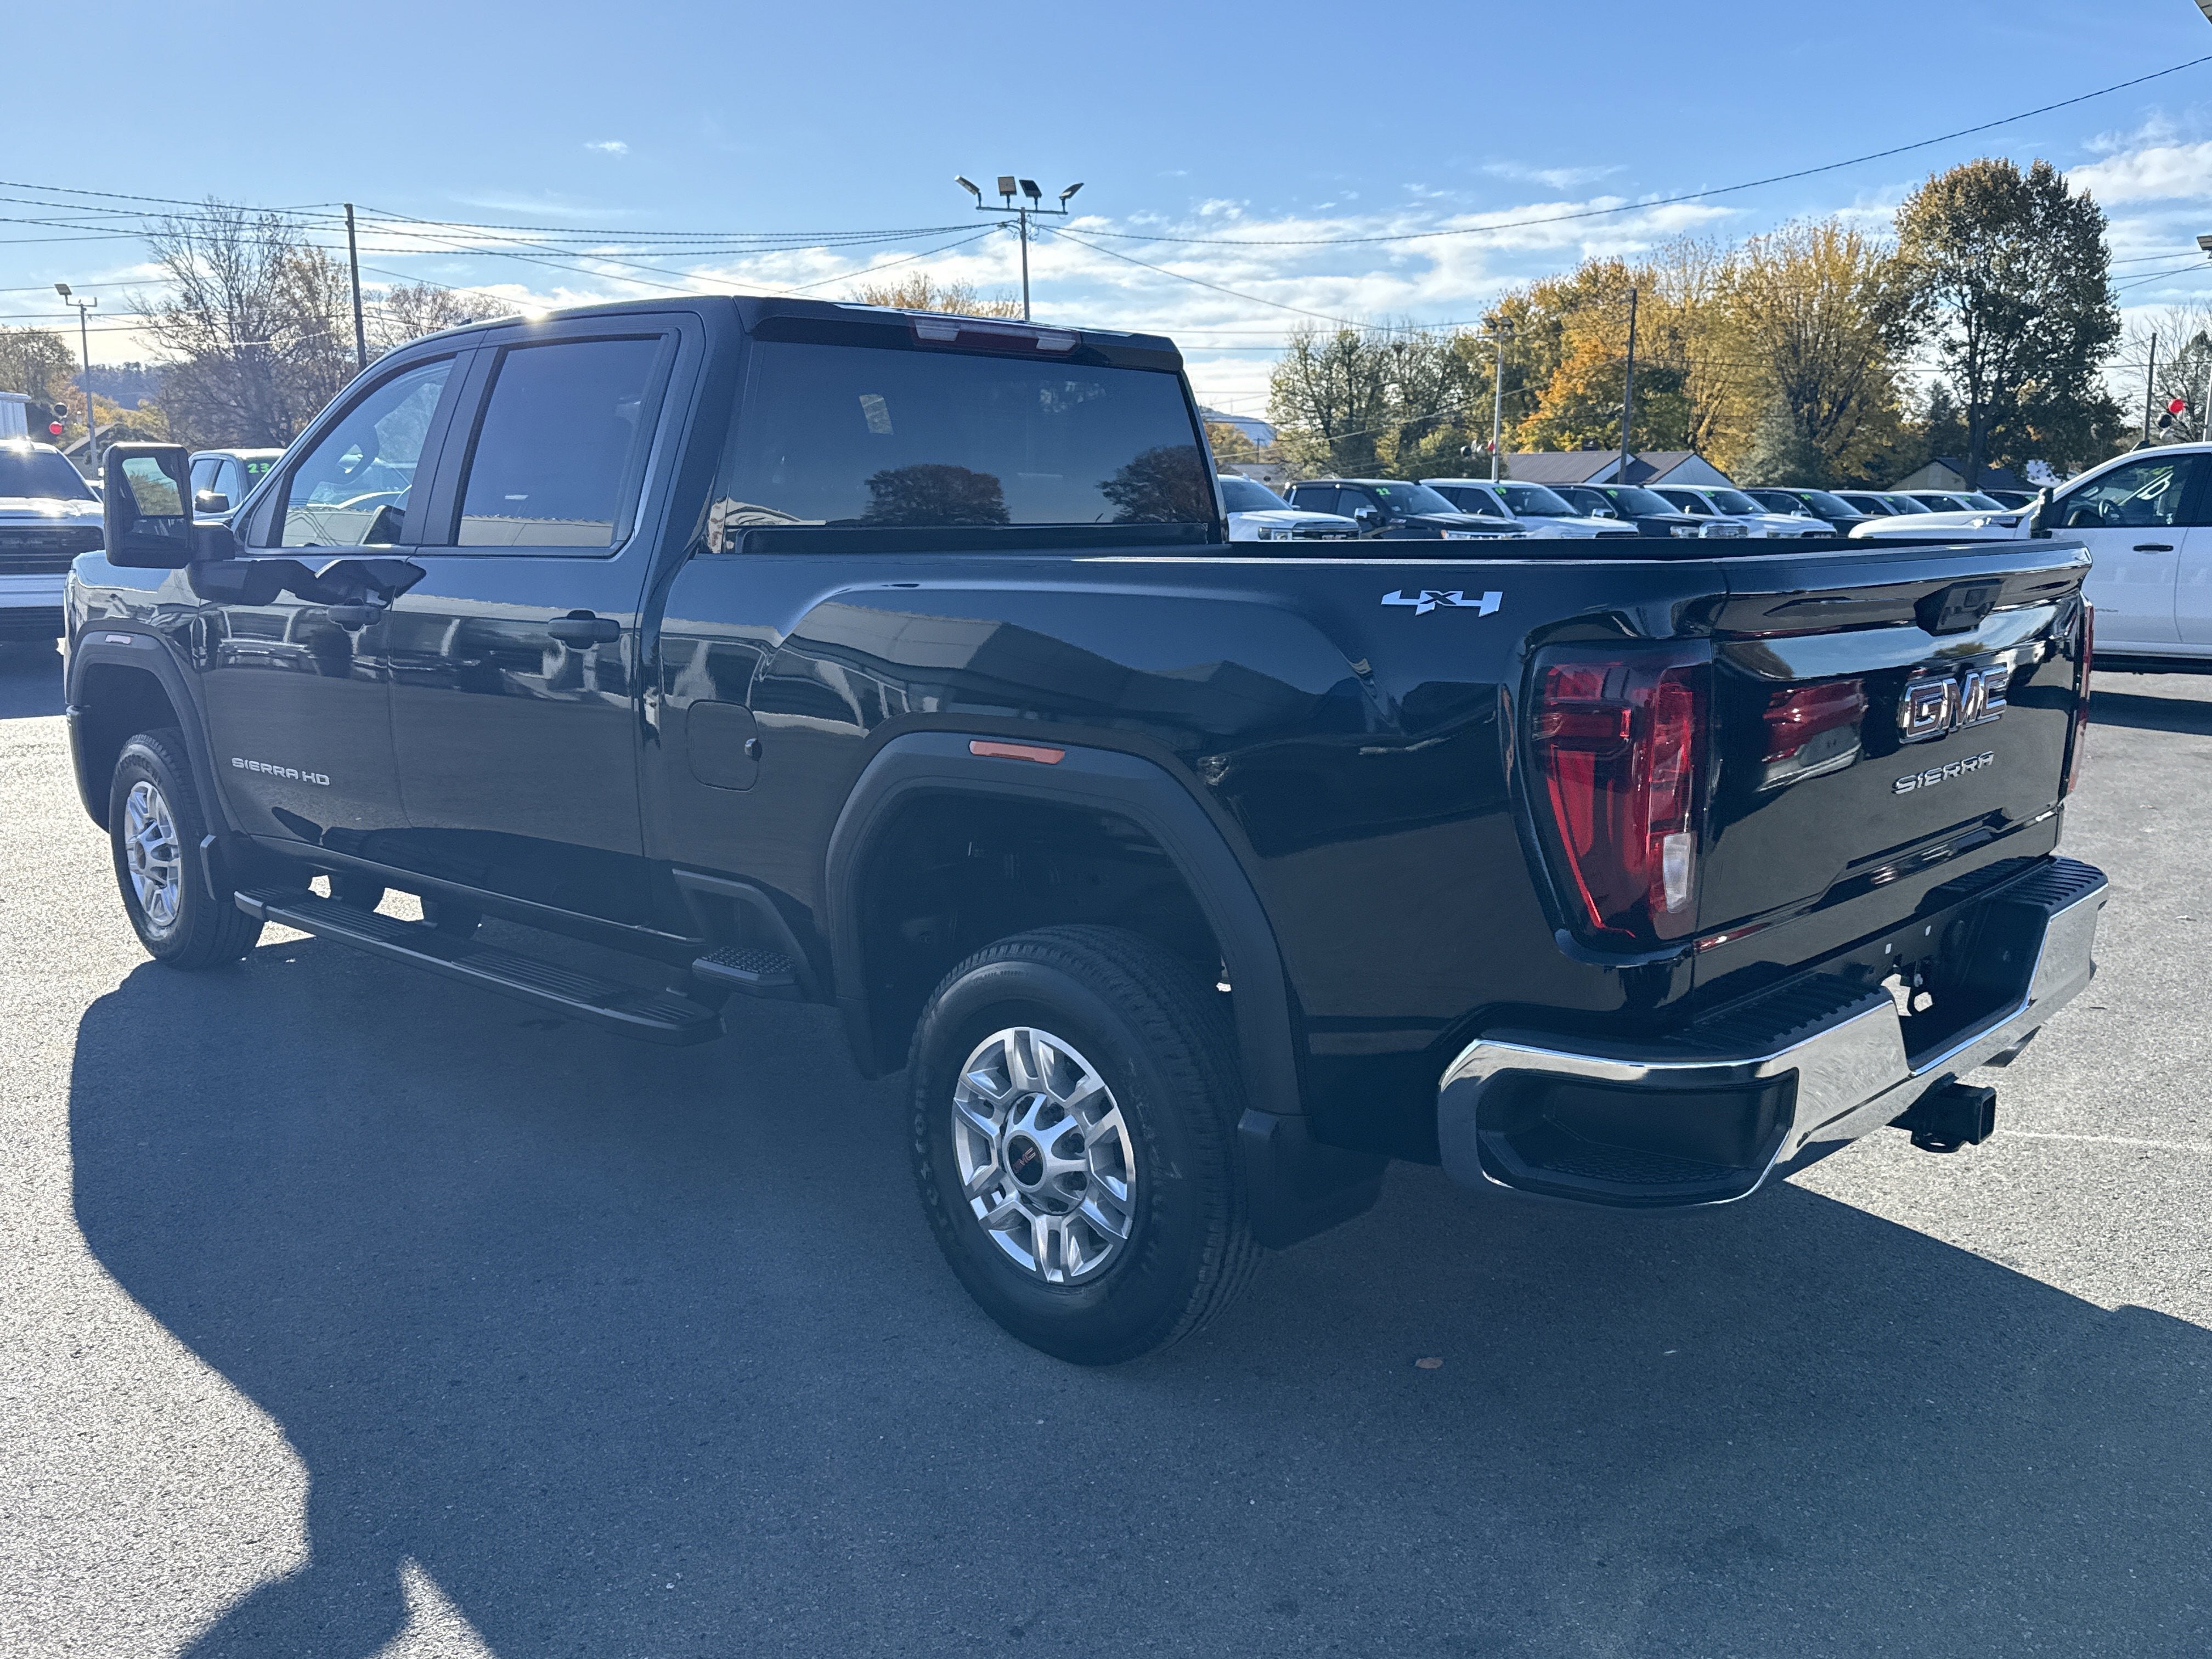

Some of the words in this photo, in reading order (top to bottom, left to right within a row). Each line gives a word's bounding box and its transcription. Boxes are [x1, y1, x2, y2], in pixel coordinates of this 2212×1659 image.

[247, 463, 269, 473] 23
[1896, 662, 2008, 744] GMC
[232, 757, 299, 780] SIERRA
[302, 771, 330, 786] HD
[1892, 751, 1994, 794] SIERRA
[1012, 1147, 1036, 1173] GMC
